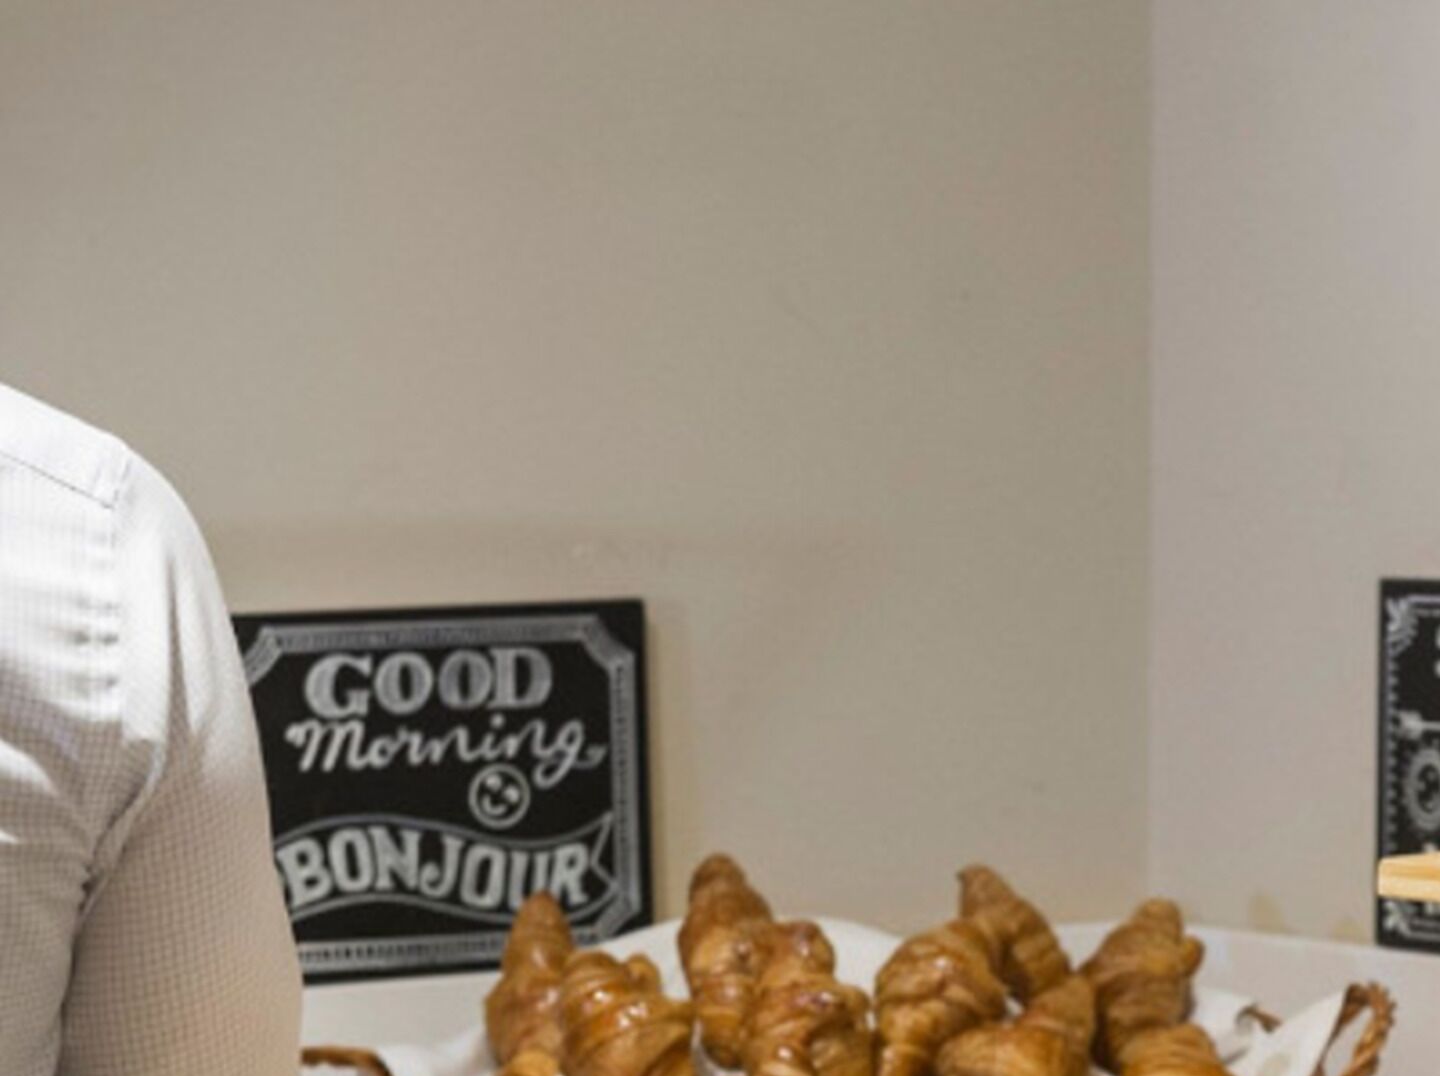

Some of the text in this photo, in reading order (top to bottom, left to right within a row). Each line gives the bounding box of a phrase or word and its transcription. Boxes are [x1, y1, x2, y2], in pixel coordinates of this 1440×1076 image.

[305, 646, 552, 719] GOOD
[285, 714, 606, 789] Morning
[276, 826, 590, 910] BONJOUR
